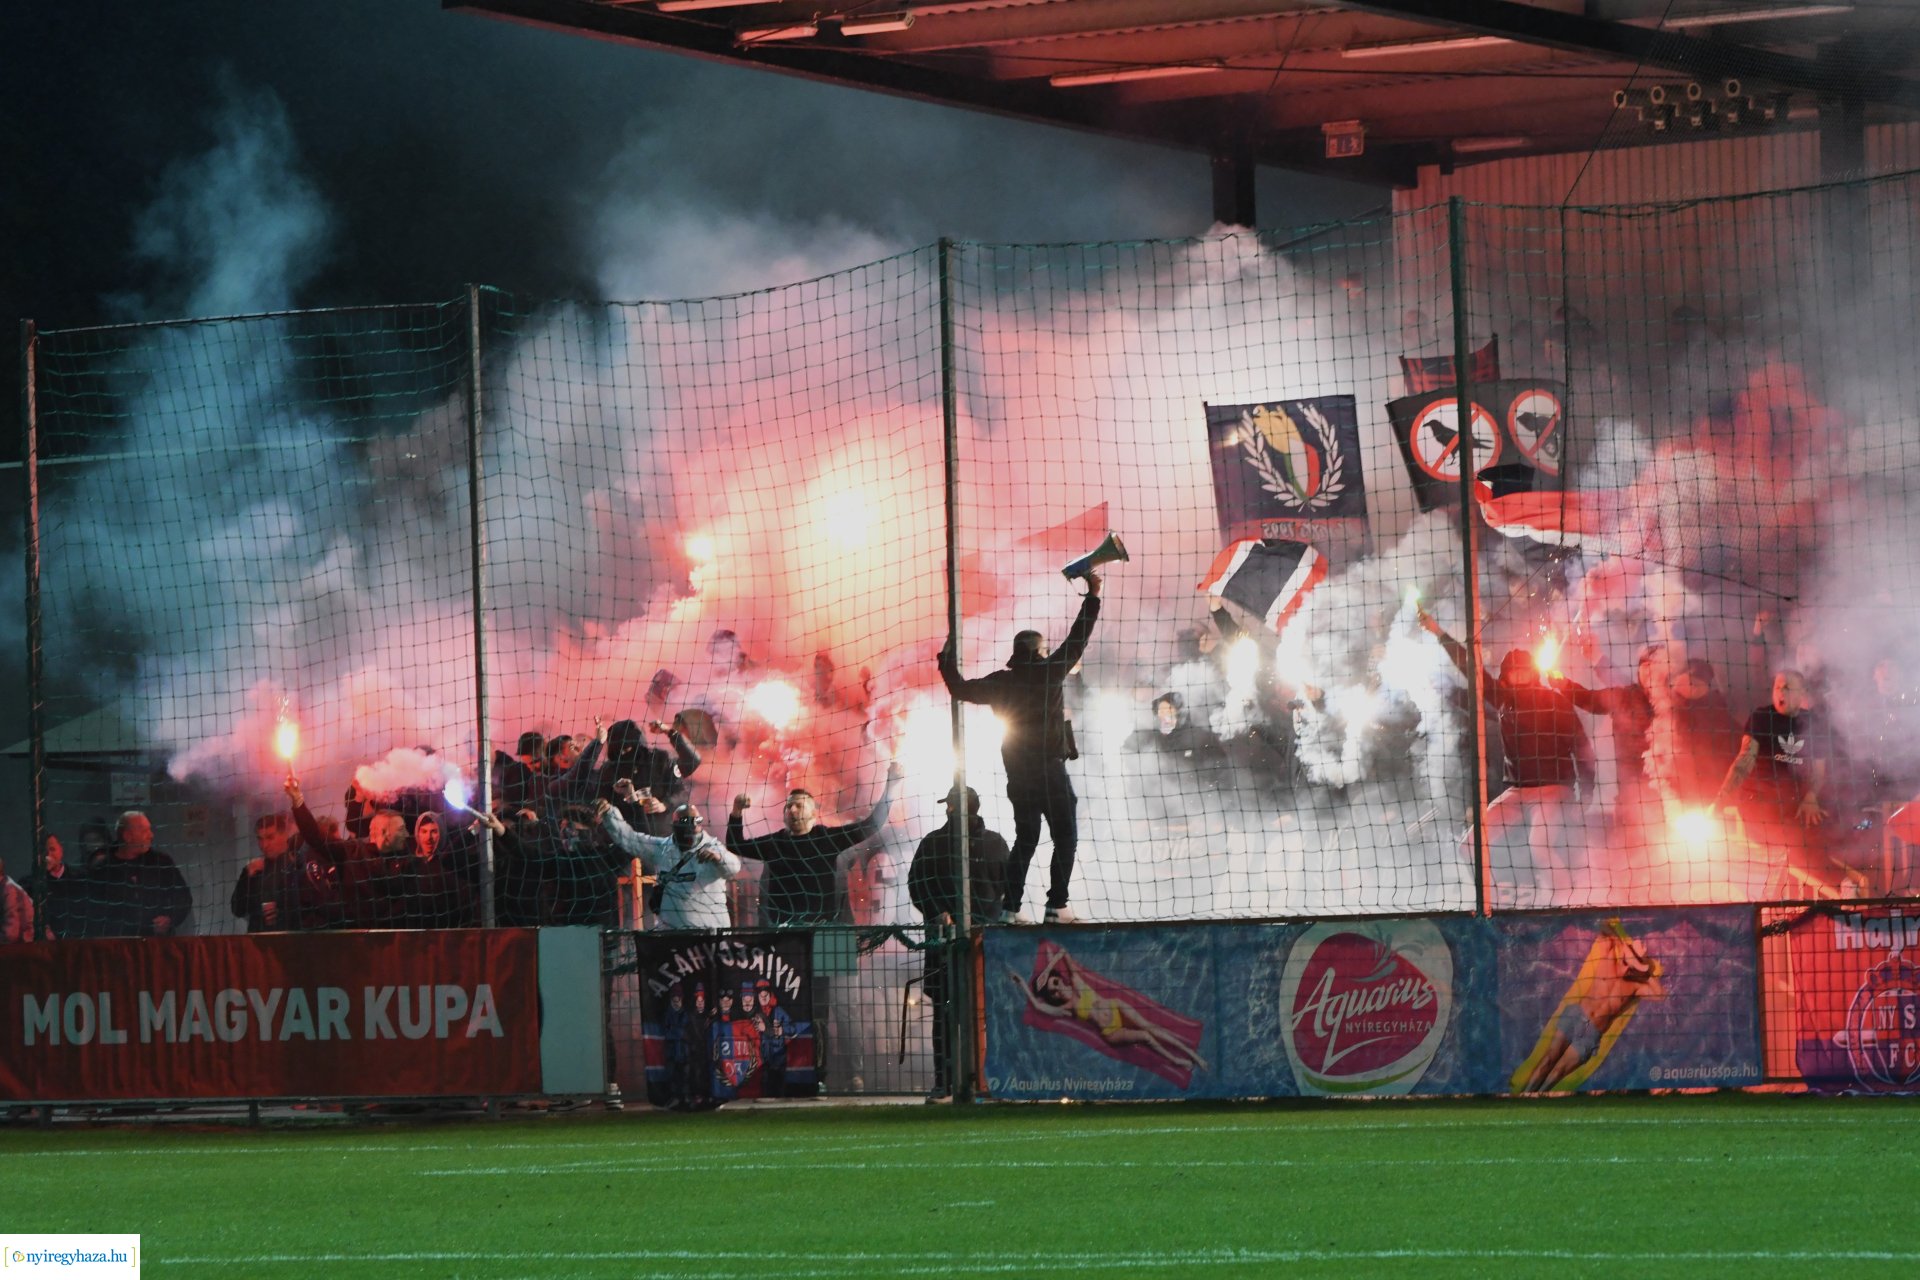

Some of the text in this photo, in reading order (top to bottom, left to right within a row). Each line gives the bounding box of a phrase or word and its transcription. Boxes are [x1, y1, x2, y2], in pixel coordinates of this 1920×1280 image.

[1775, 754, 1803, 764] adidas
[23, 983, 504, 1046] MOL MAGYAR KUPA
[1292, 967, 1437, 1074] Aquarius
[1345, 1019, 1432, 1033] NYÍREGYHÁZA
[1663, 1062, 1758, 1082] aquariusspa.hu
